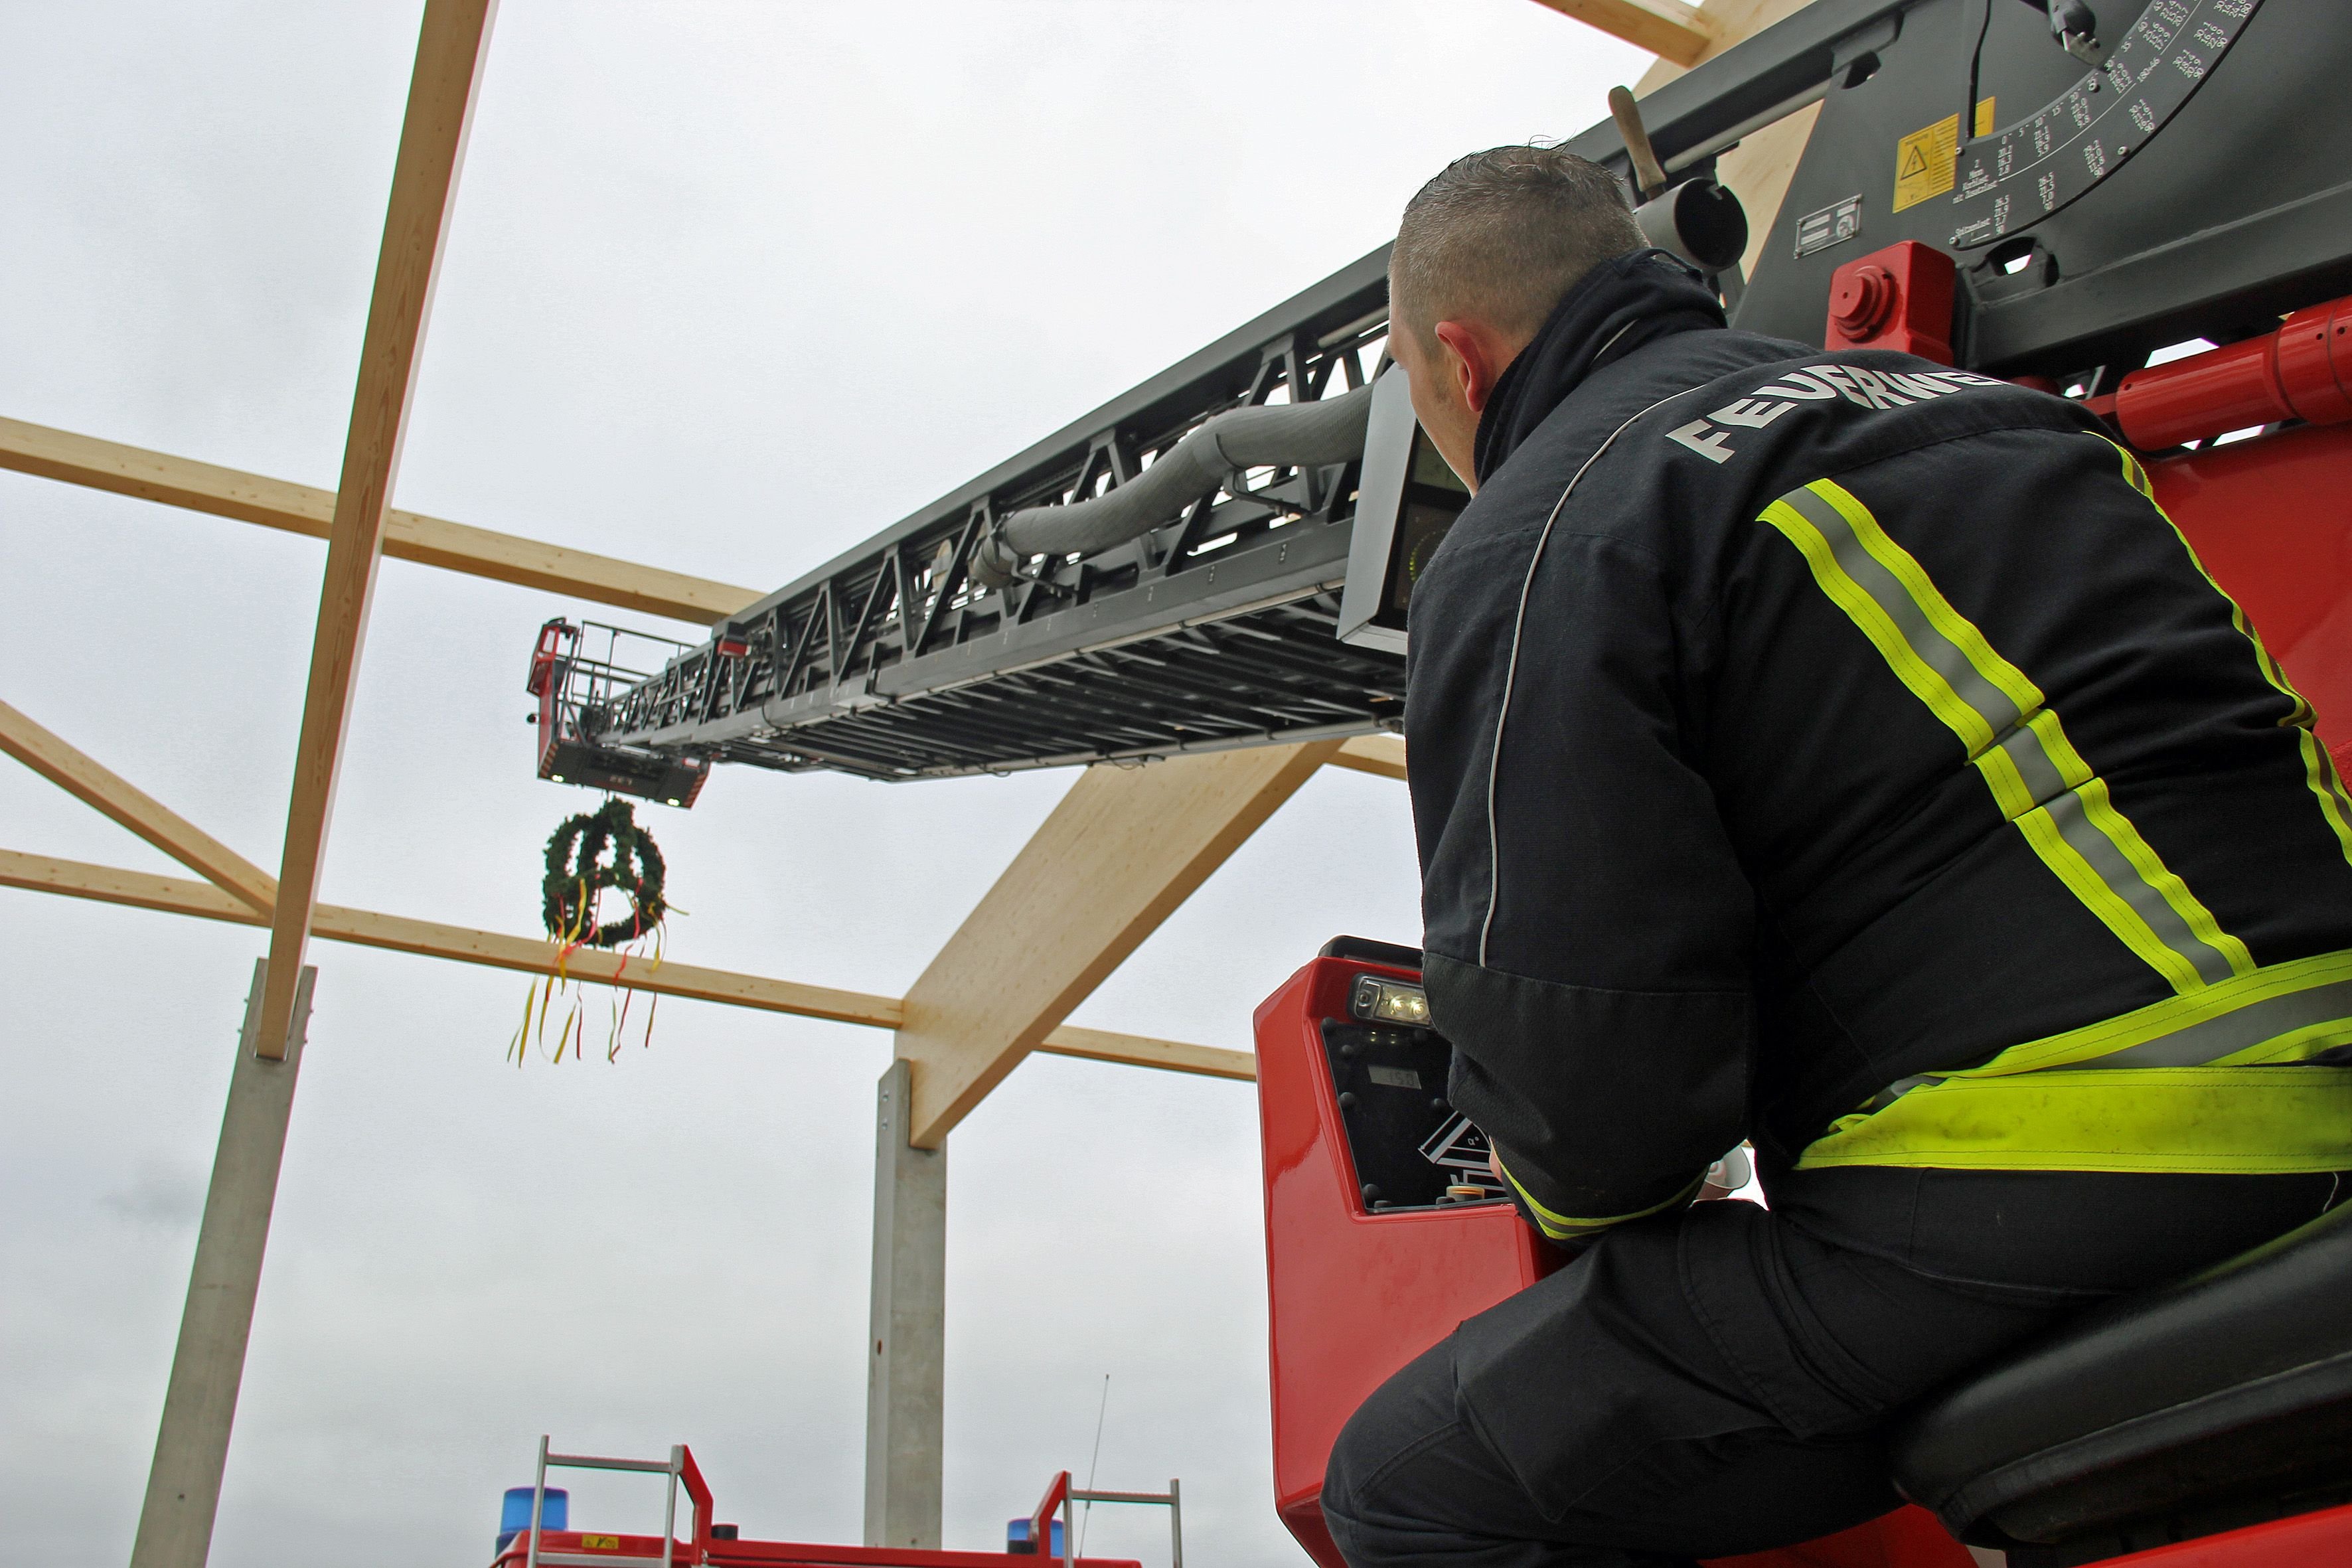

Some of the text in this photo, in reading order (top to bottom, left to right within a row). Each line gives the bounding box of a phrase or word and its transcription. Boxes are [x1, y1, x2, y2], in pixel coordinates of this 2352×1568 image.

[2238, 3, 2252, 19] 180
[2193, 21, 2211, 40] 30.1
[2216, 37, 2228, 48] 90
[2193, 67, 2205, 79] 90
[1665, 364, 2011, 465] FEUERWE
